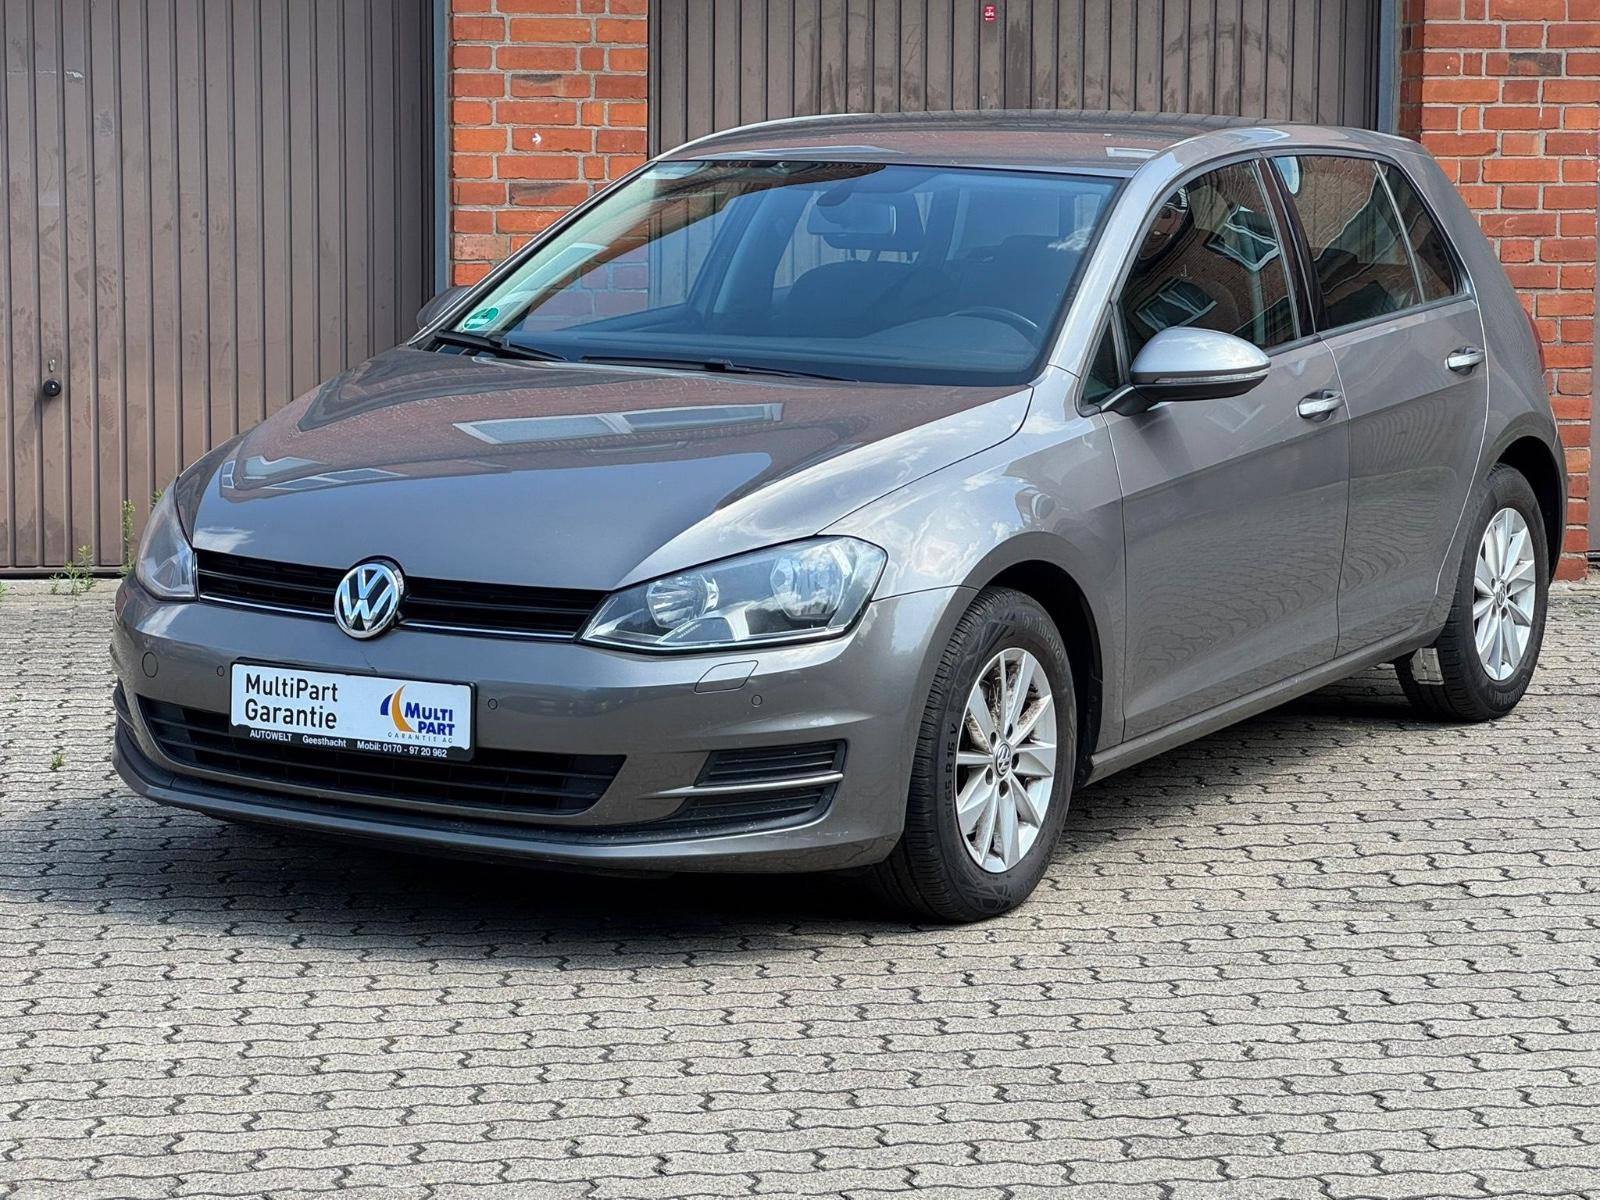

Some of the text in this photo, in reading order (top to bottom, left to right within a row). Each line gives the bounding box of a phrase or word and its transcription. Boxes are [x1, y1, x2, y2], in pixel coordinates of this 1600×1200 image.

[335, 563, 399, 638] VW
[245, 673, 338, 702] MultiPart
[245, 698, 337, 729] Garantie
[404, 702, 453, 722] MULTI
[387, 731, 437, 742] GARANTIE
[417, 721, 455, 736] PART
[250, 729, 292, 742] AUTOWELT
[302, 735, 346, 748] Geesthacht
[357, 740, 381, 751] Mobil:
[382, 743, 402, 753] 0170
[409, 746, 419, 755] 97
[420, 747, 431, 756] 20
[432, 748, 447, 758] 962
